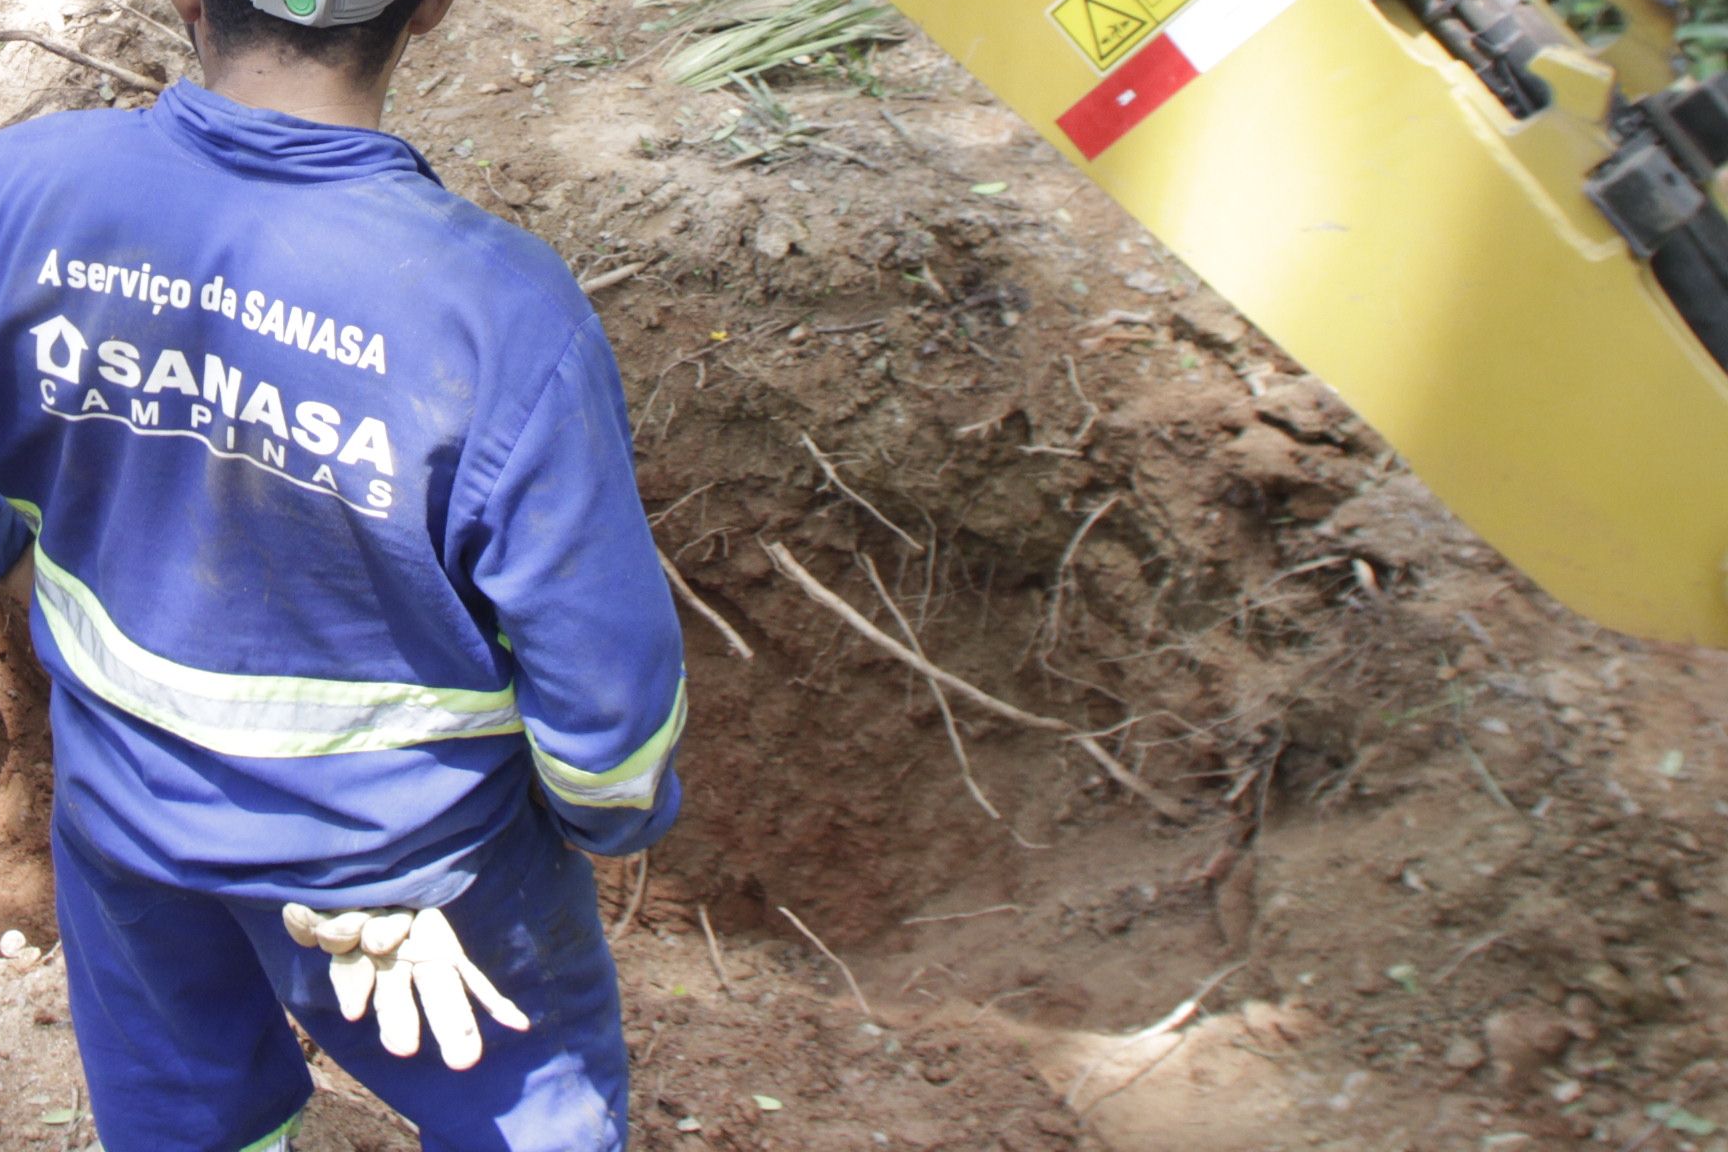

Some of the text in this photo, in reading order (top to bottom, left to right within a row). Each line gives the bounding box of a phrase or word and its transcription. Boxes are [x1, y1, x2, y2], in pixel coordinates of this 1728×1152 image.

[37, 249, 387, 375] A serviço da SANASA
[40, 378, 394, 508] CAMPINAS
[98, 339, 395, 476] SANASA
